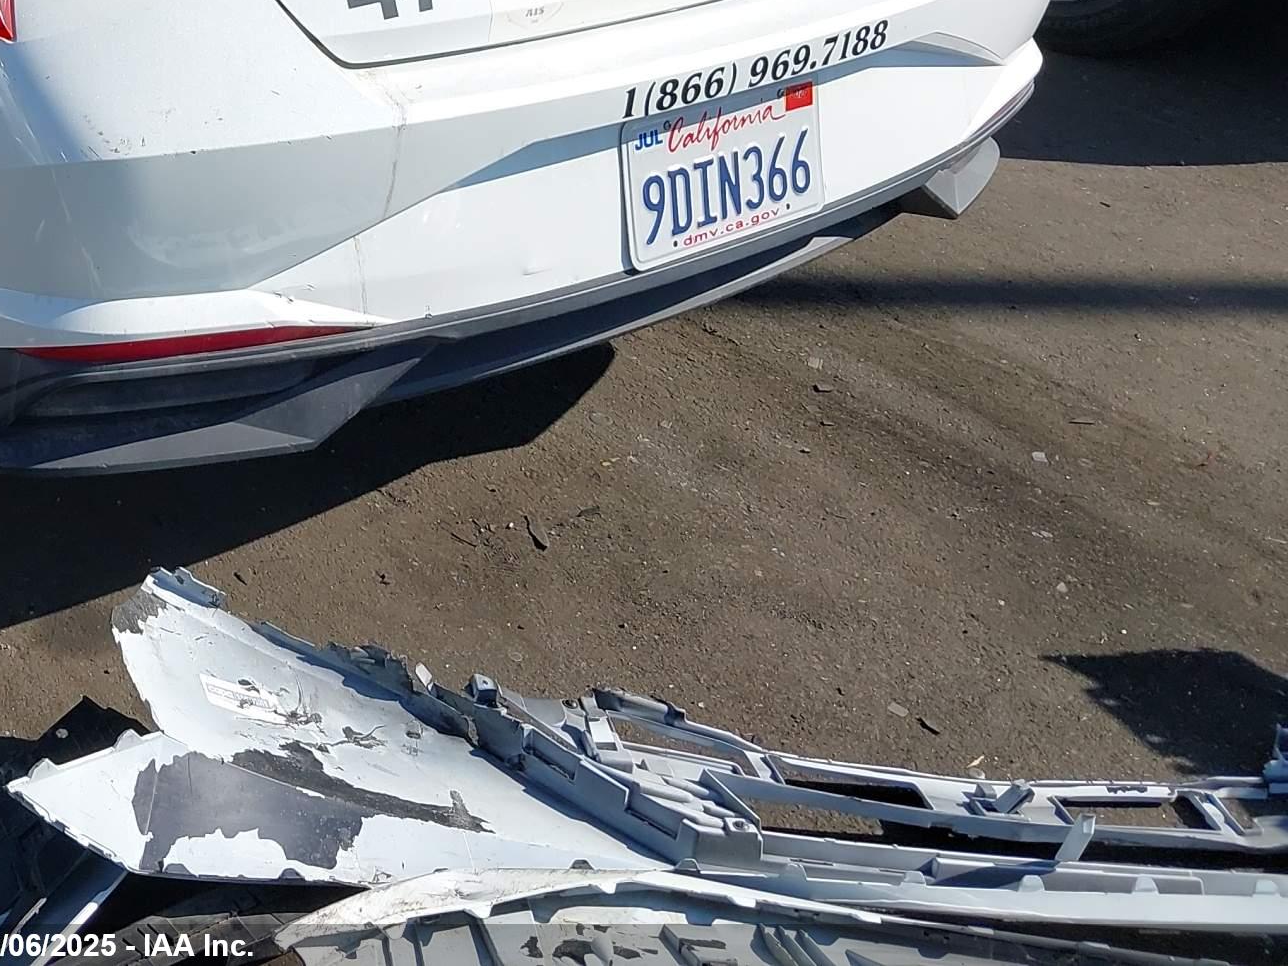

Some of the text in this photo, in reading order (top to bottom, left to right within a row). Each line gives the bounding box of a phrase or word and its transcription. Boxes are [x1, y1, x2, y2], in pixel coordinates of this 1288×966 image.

[621, 19, 889, 120] 1(866) 969.7188
[634, 130, 663, 151] JUL
[667, 104, 785, 153] California
[642, 127, 811, 246] 9DIN366
[683, 206, 780, 247] dmv.ca.gov
